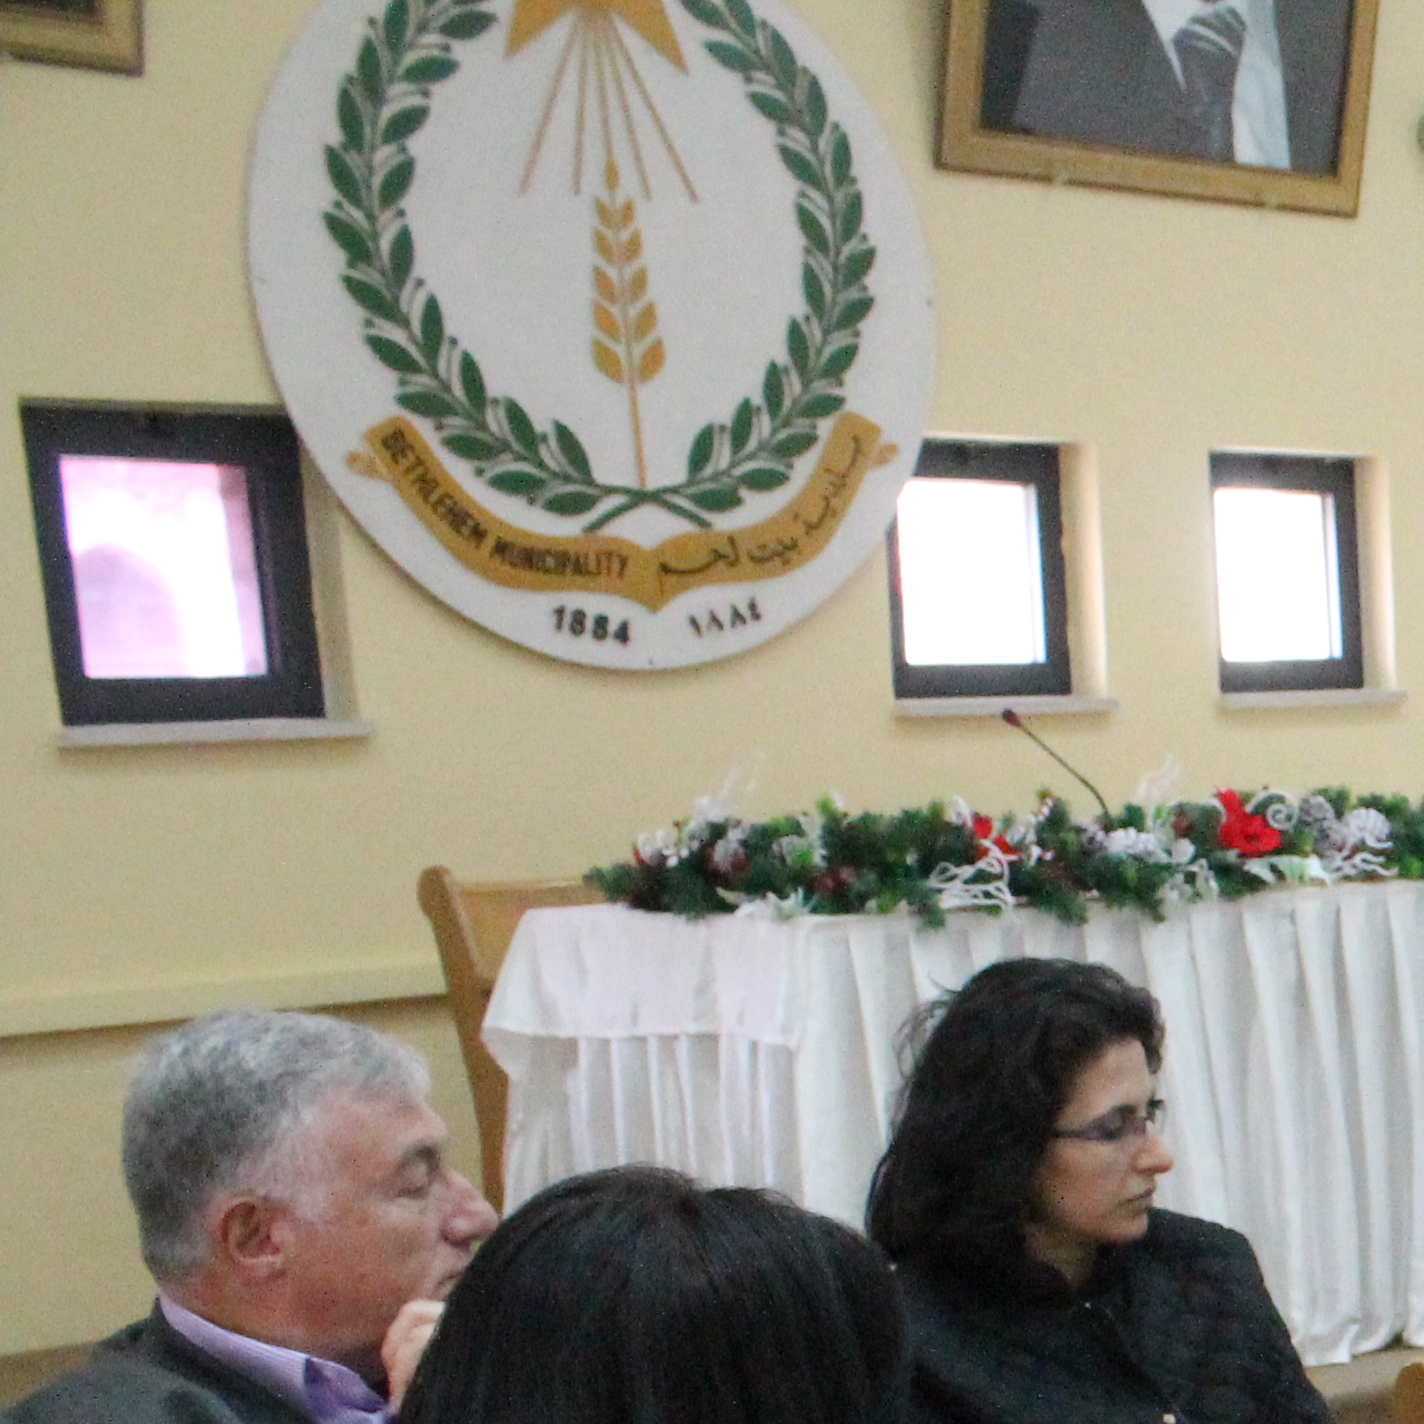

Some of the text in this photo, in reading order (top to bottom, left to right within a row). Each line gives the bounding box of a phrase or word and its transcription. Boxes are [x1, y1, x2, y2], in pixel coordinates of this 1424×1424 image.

[381, 427, 629, 579] BETHLEHEM MUNICIPALITY
[659, 534, 741, 575] لحم
[746, 535, 799, 567] بيت
[552, 604, 631, 644] 1884
[688, 596, 763, 638] ١٨٨٤
